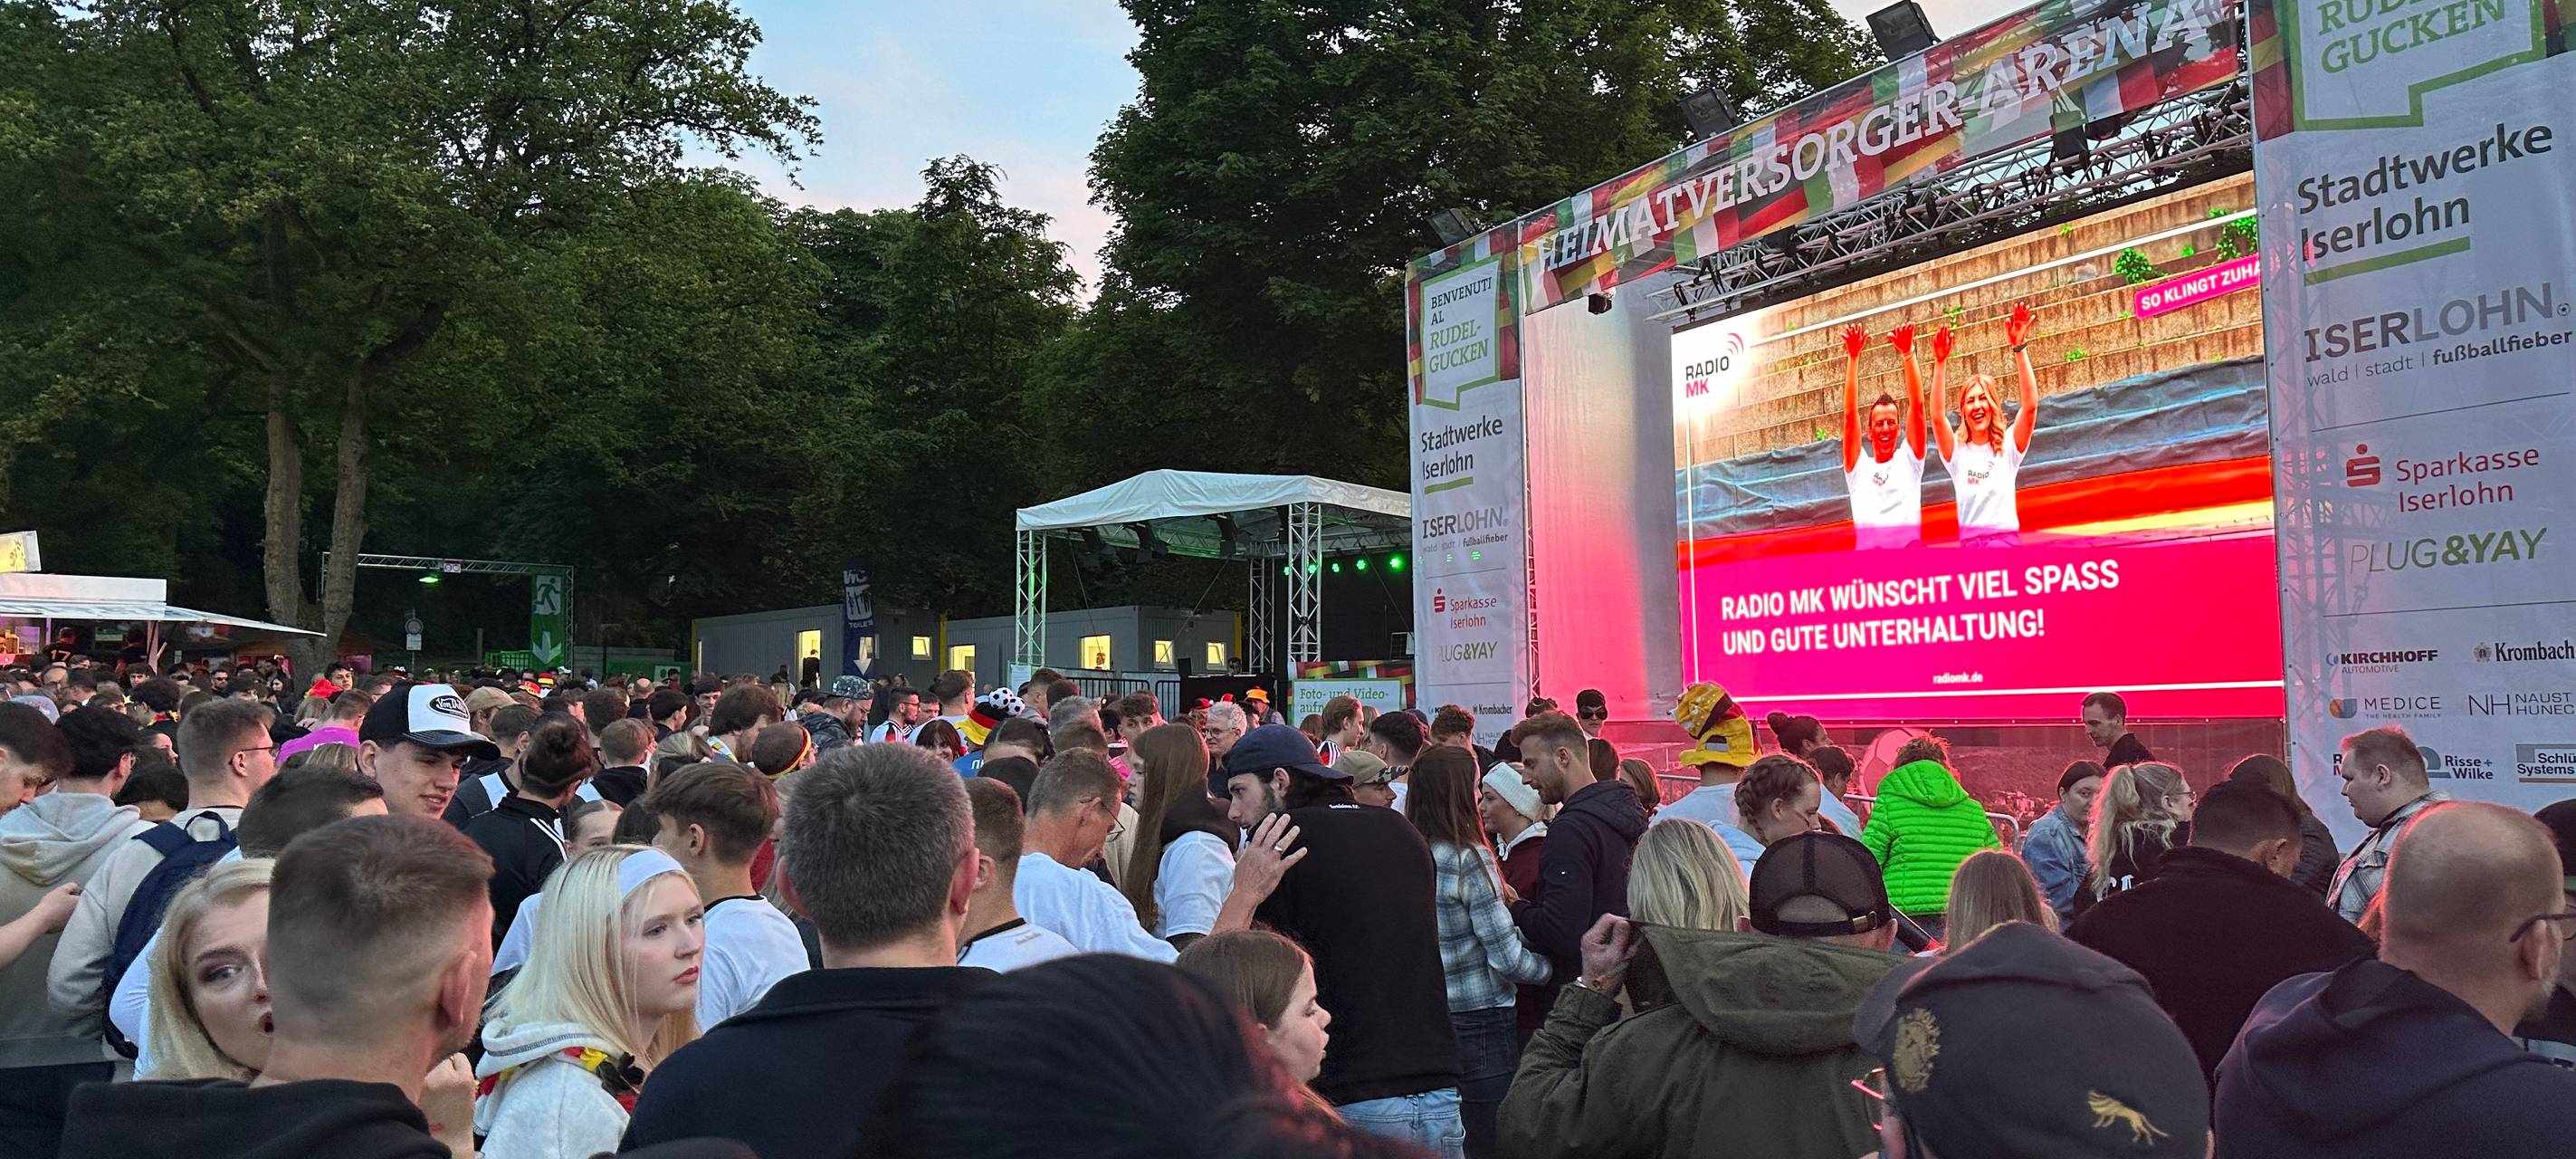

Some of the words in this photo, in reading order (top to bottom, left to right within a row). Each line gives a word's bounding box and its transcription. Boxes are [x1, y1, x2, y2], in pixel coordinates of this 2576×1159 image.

[2320, 0, 2505, 74] GUCKEN
[2297, 123, 2552, 215] Stadtwerke
[2302, 196, 2470, 262] Iserlohn
[1431, 276, 1492, 309] BENVENUTI
[2141, 293, 2161, 311] SO
[2164, 274, 2217, 303] KLINGT
[1431, 311, 1445, 325] AL
[1429, 320, 1482, 350] RUDEL-
[1429, 339, 1489, 373] GUCKEN
[2307, 366, 2349, 387] wald
[2365, 356, 2414, 378] stadt
[2433, 328, 2572, 367] fußballfieber
[1685, 356, 1730, 381] RADIO
[1685, 378, 1709, 398] MK
[1422, 415, 1503, 453] Stadtwerke
[1422, 451, 1474, 481] Iserlohn
[2395, 448, 2540, 485] Sparkasse
[2399, 482, 2514, 512] Iserlohn
[2350, 527, 2547, 574] PLUG&YAY
[843, 570, 869, 585] WC
[1722, 591, 1785, 620] RADIO
[1789, 588, 1826, 615] MK
[1829, 575, 1952, 611] WÜNSCHT
[1958, 570, 2018, 600] VIEL
[2024, 559, 2120, 595] SPASS
[1450, 597, 1497, 614] Sparkasse
[1450, 614, 1486, 629] Iserlohn
[1722, 629, 1766, 656] UND
[1770, 625, 1828, 653] GUTE
[1833, 608, 2046, 648] UNTERHALTUNG!
[51, 650, 71, 661] 17
[2341, 649, 2438, 665] KIRCHHOFF
[2495, 640, 2575, 662] Krombach
[1932, 671, 1983, 685] radiomk.de
[2341, 665, 2399, 674] AUTOMOTIVE
[1300, 688, 1326, 700] Foto-
[1354, 688, 1389, 700] Video-
[2364, 696, 2441, 711] MEDICE
[2468, 694, 2511, 716] NH
[2515, 693, 2571, 704] NAUST
[1478, 704, 1513, 715] Krombacher
[2445, 754, 2481, 768] Risse
[2538, 752, 2576, 764] Schlü
[2452, 768, 2494, 780] Wilke
[2516, 764, 2575, 777] Systems
